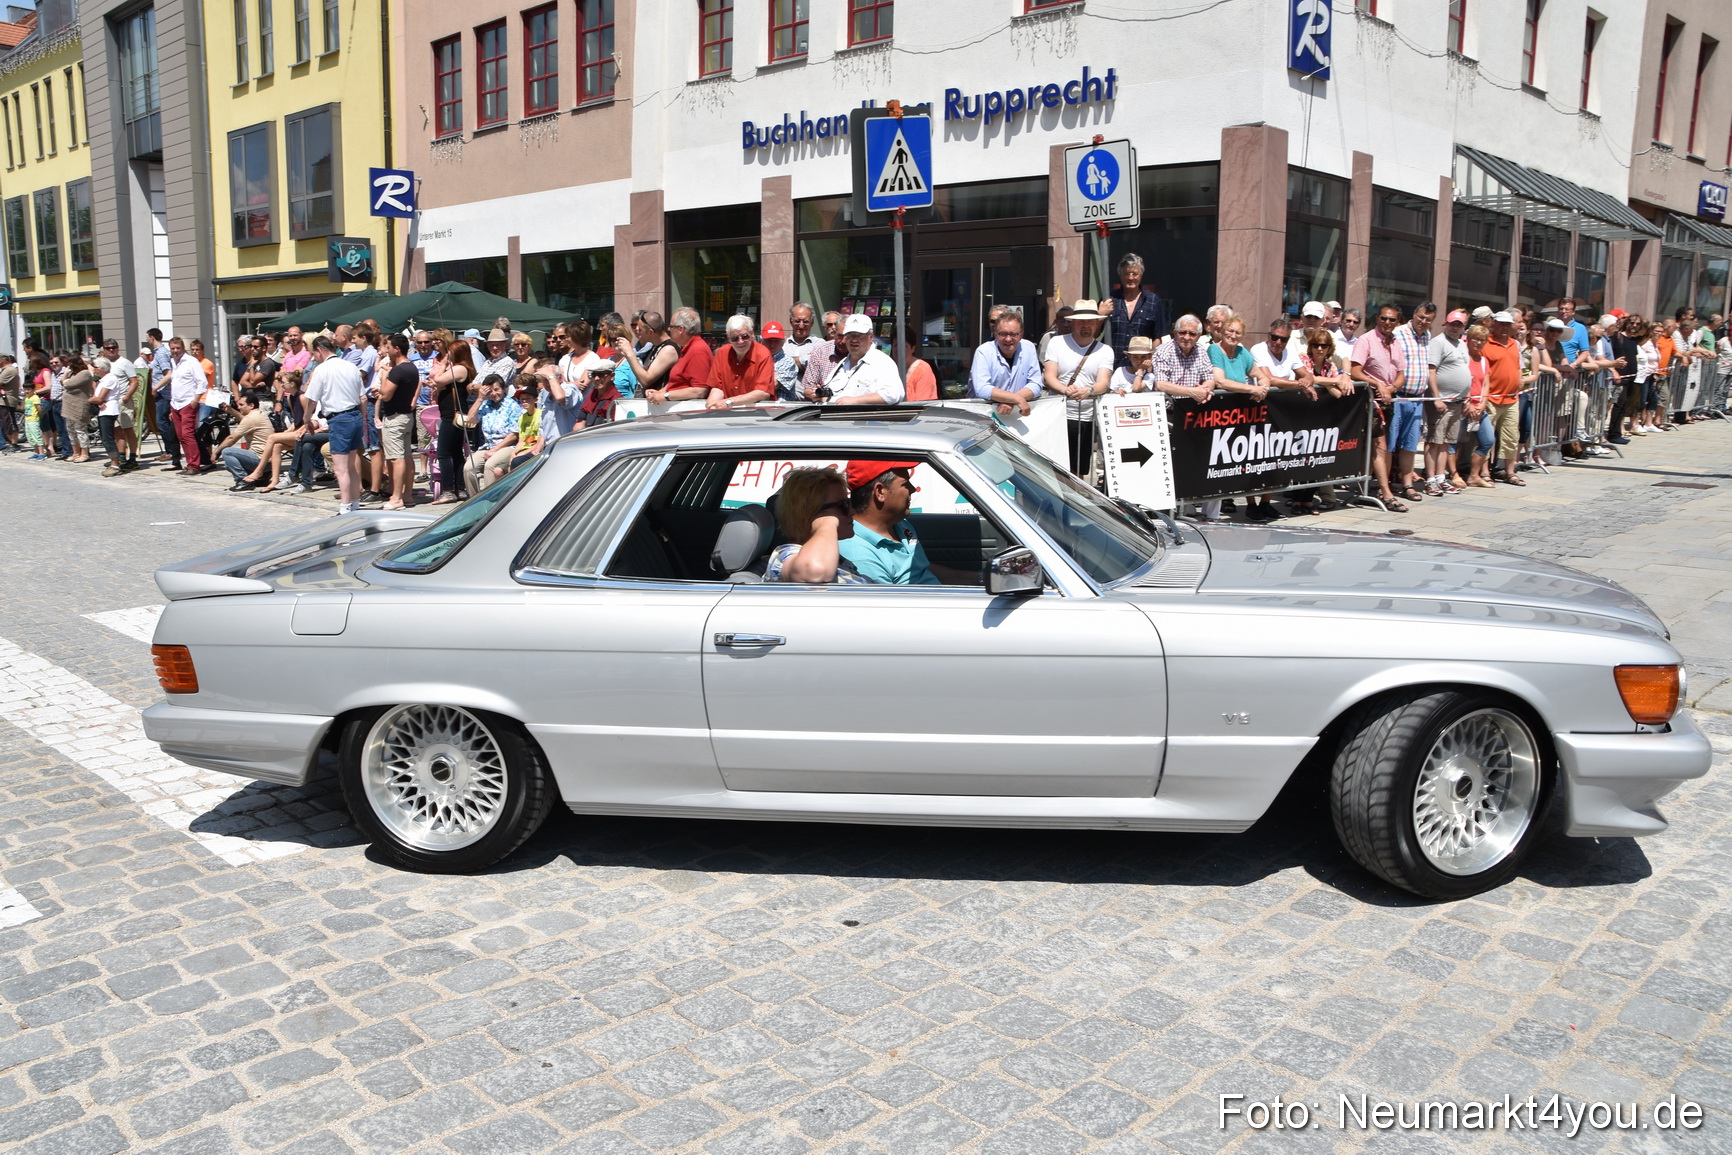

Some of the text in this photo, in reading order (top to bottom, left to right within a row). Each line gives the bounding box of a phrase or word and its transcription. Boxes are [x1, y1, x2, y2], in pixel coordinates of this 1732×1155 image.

[742, 66, 1117, 150] Buchhan Rupprecht
[1084, 203, 1116, 218] ZONE
[1184, 405, 1268, 430] FAHRSCHULE
[1155, 402, 1171, 497] RESIDENZPLATZ
[1209, 423, 1358, 466] Kohlmann GmbH
[1207, 465, 1242, 480] Neumarkt
[1308, 455, 1335, 467] Pyrbaum
